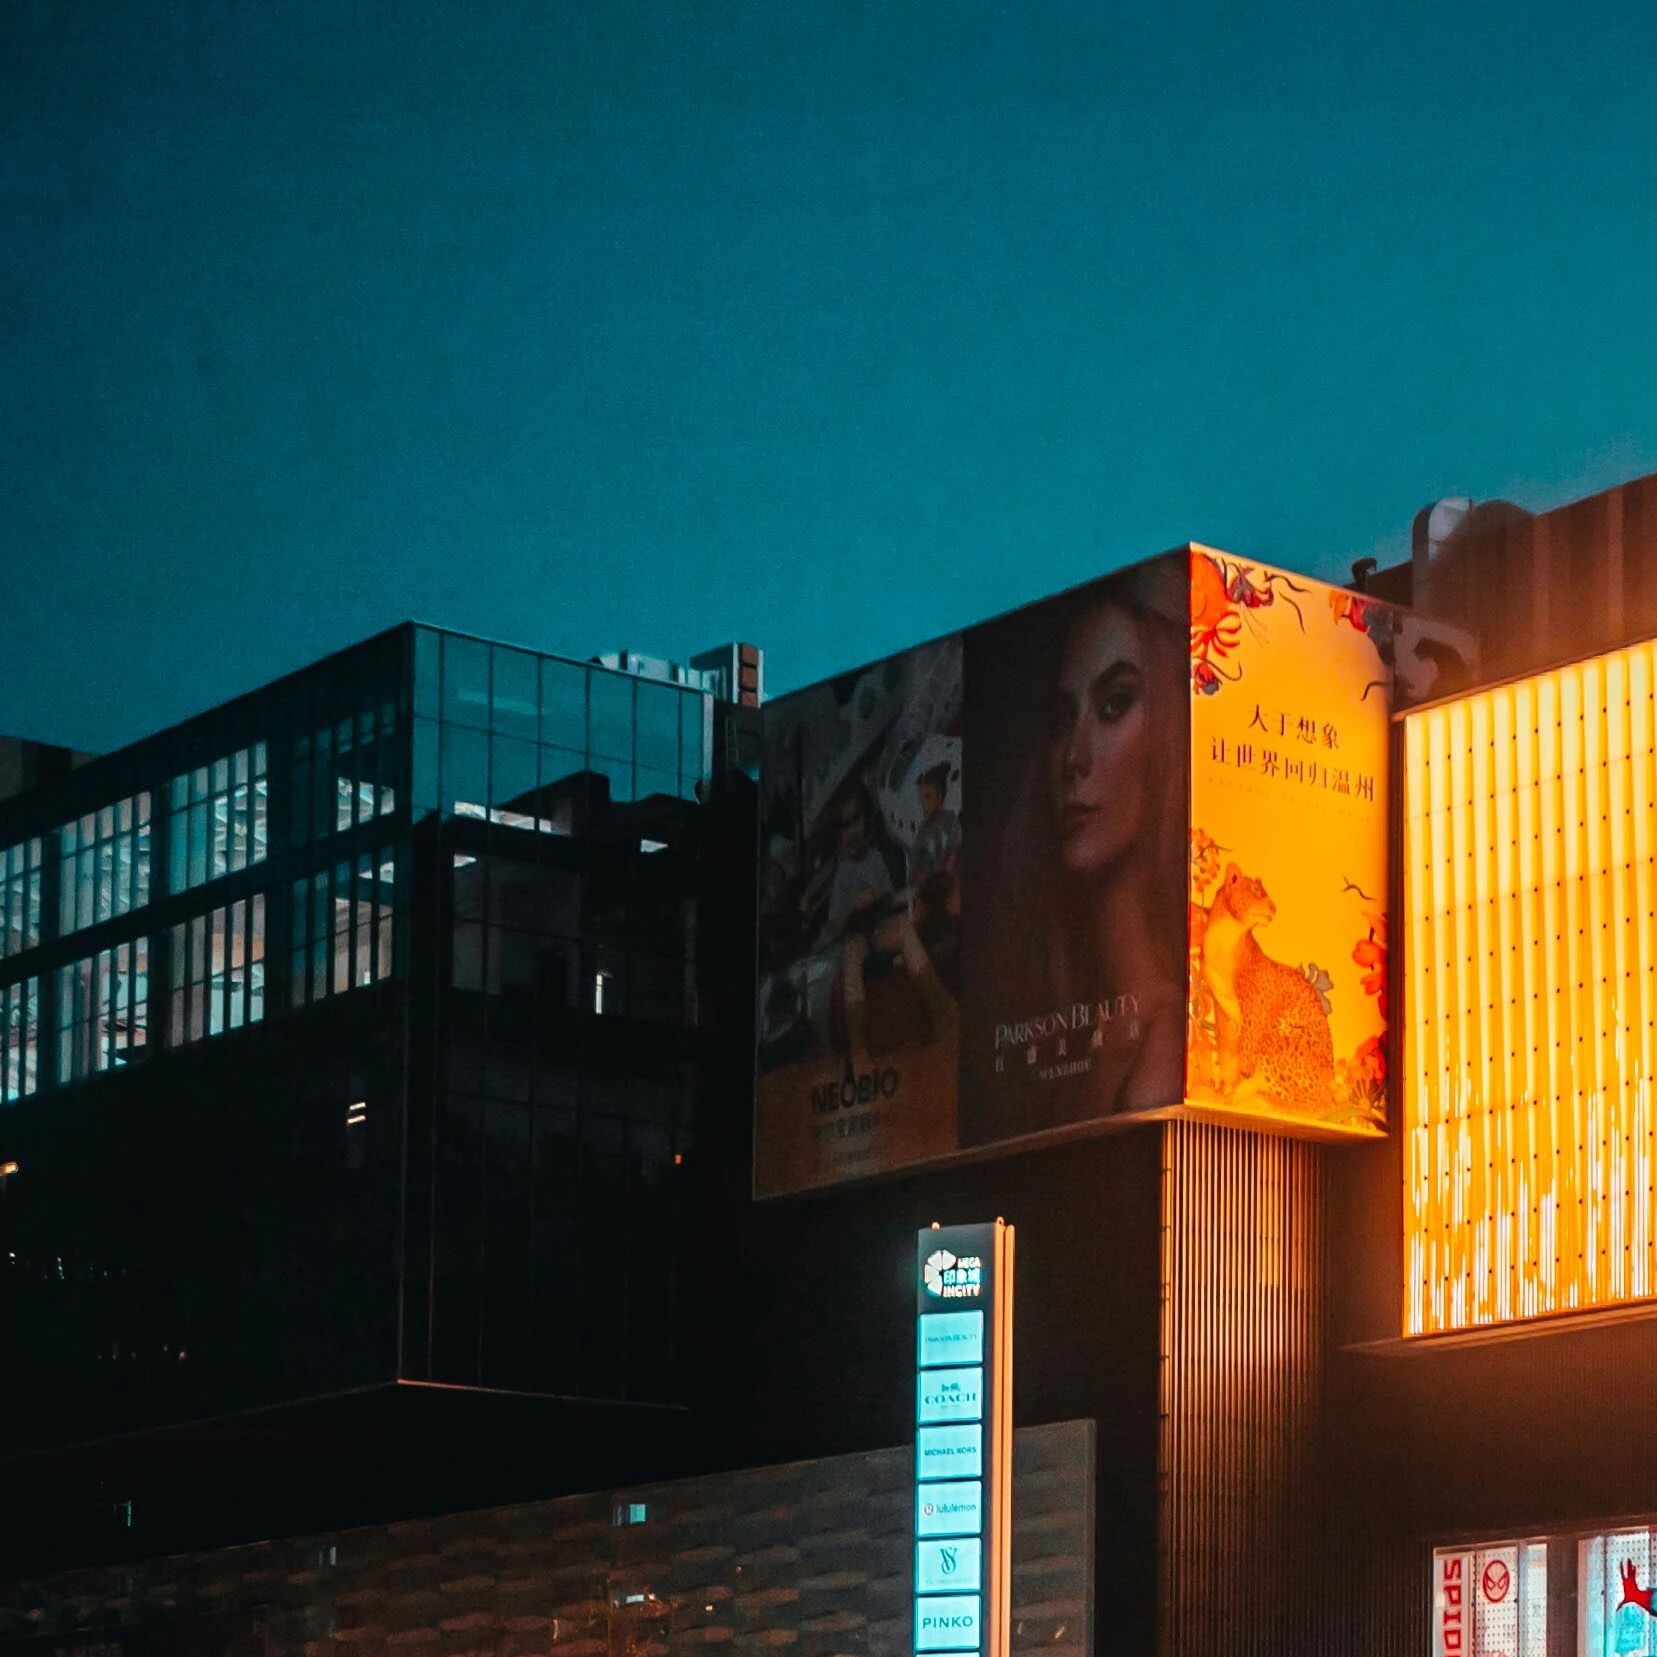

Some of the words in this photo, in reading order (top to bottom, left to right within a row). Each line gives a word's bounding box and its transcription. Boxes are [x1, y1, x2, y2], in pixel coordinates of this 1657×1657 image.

[1209, 735, 1375, 803] 让世界回归温州
[995, 1011, 1067, 1050] PARKSON
[1072, 992, 1141, 1030] BEAUTY
[811, 1067, 898, 1114] NEOBIO
[943, 1283, 981, 1298] INCITY
[925, 1392, 977, 1405] COACH
[924, 1448, 954, 1457] MICHAEL
[956, 1446, 977, 1454] KORS
[936, 1503, 977, 1514] lululemon
[922, 1615, 974, 1630] PINKO
